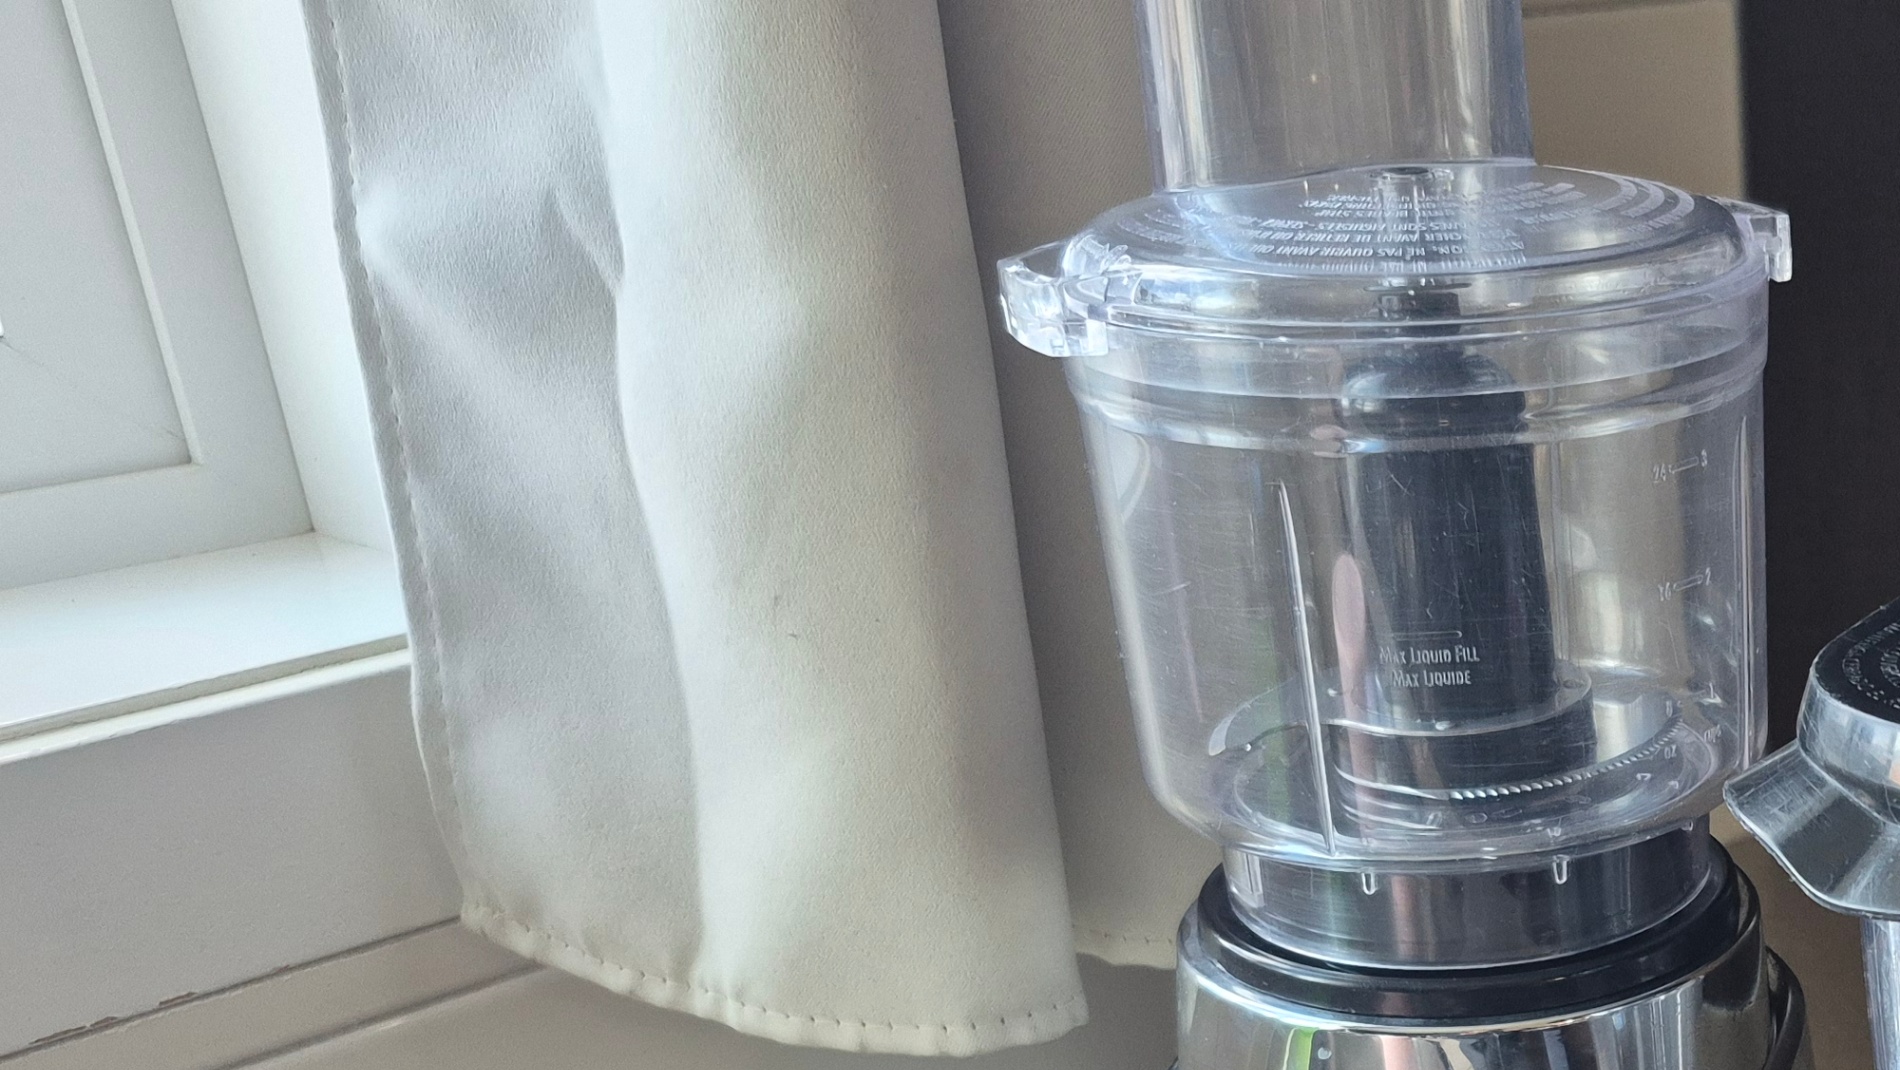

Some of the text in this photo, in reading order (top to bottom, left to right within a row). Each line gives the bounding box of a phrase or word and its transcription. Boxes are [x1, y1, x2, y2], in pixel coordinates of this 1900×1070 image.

[1273, 246, 1320, 256] AVANT
[1319, 246, 1374, 257] OUVRIR
[1377, 247, 1402, 257] PAS
[1454, 644, 1481, 663] FILL
[1423, 669, 1472, 688] LIQUIDE
